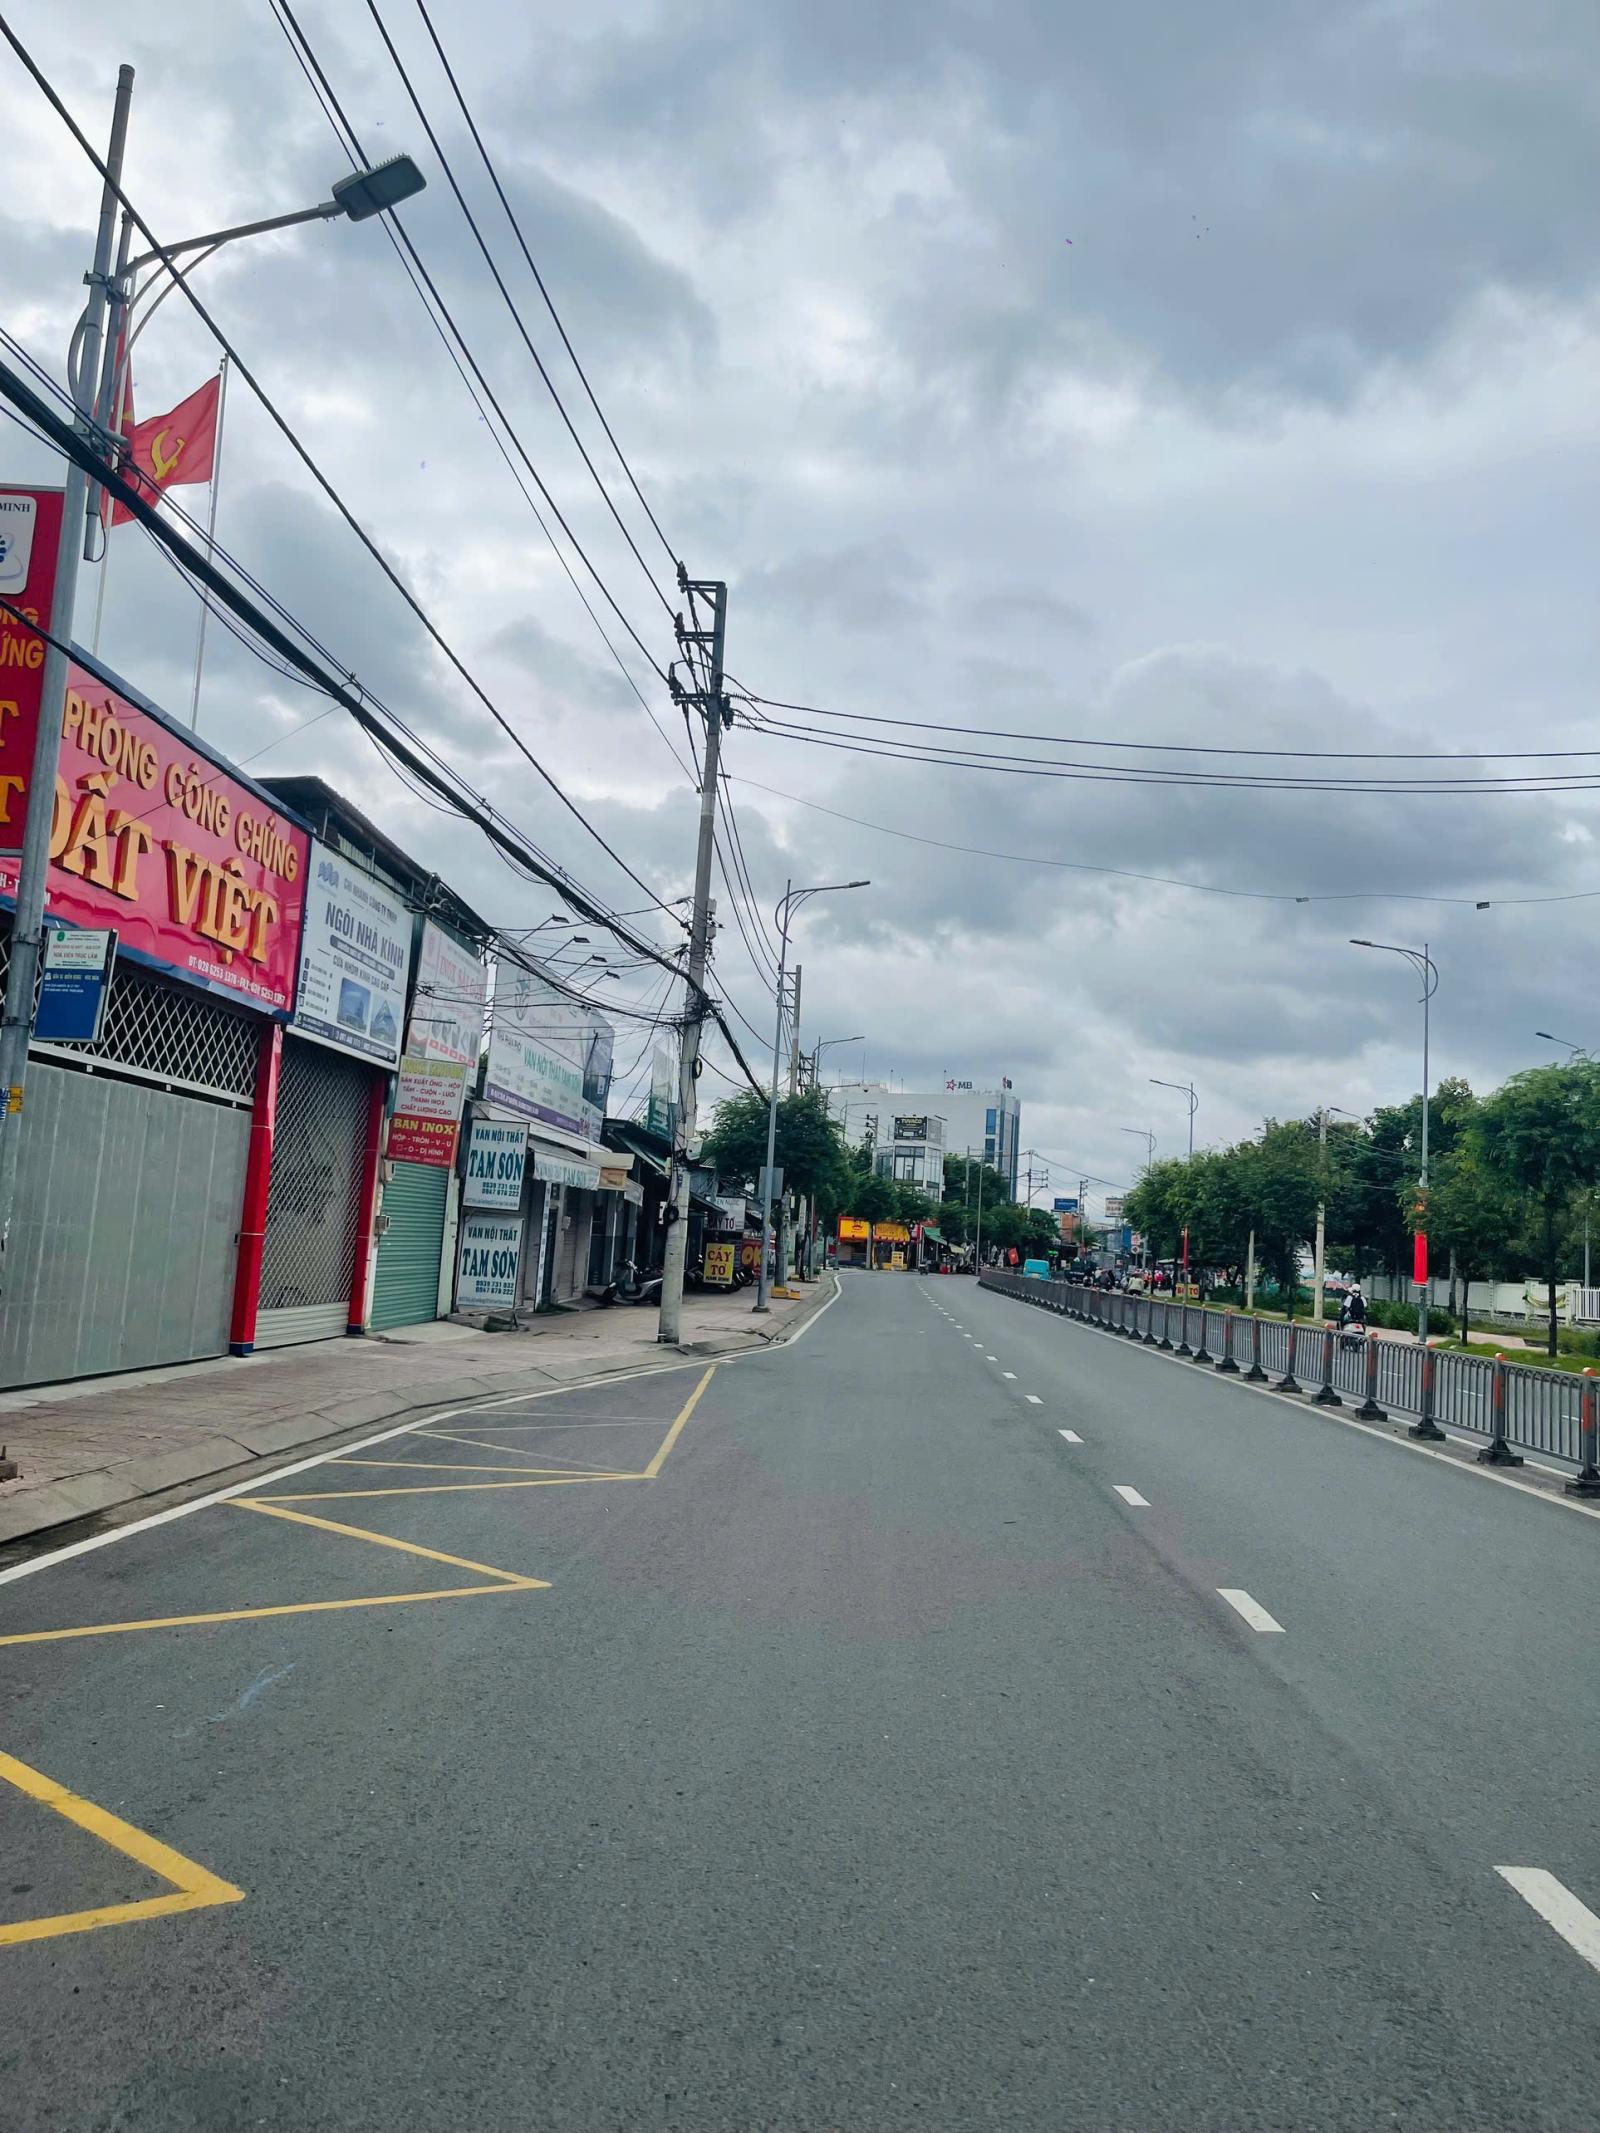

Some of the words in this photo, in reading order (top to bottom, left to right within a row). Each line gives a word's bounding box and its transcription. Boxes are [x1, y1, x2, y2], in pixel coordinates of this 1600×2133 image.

[62, 687, 158, 790] PHÒNG
[164, 762, 231, 838] CÔNG
[235, 811, 298, 882] CHỨNG
[161, 840, 278, 966] VIỆT
[325, 901, 355, 939] NGÔI
[380, 936, 405, 969] KÍNH
[957, 1081, 973, 1090] MB
[438, 1108, 452, 1116] CAO
[421, 1121, 455, 1136] INOX
[491, 1127, 505, 1144] NỘI
[506, 1127, 525, 1144] THẤT
[469, 1149, 497, 1179] TAM
[497, 1147, 524, 1182] SƠN
[497, 1183, 508, 1191] 731
[484, 1225, 498, 1243] NỘI
[499, 1225, 518, 1242] THẤT
[462, 1247, 490, 1277] TAM
[490, 1245, 518, 1279] SƠN
[502, 1288, 514, 1296] 222
